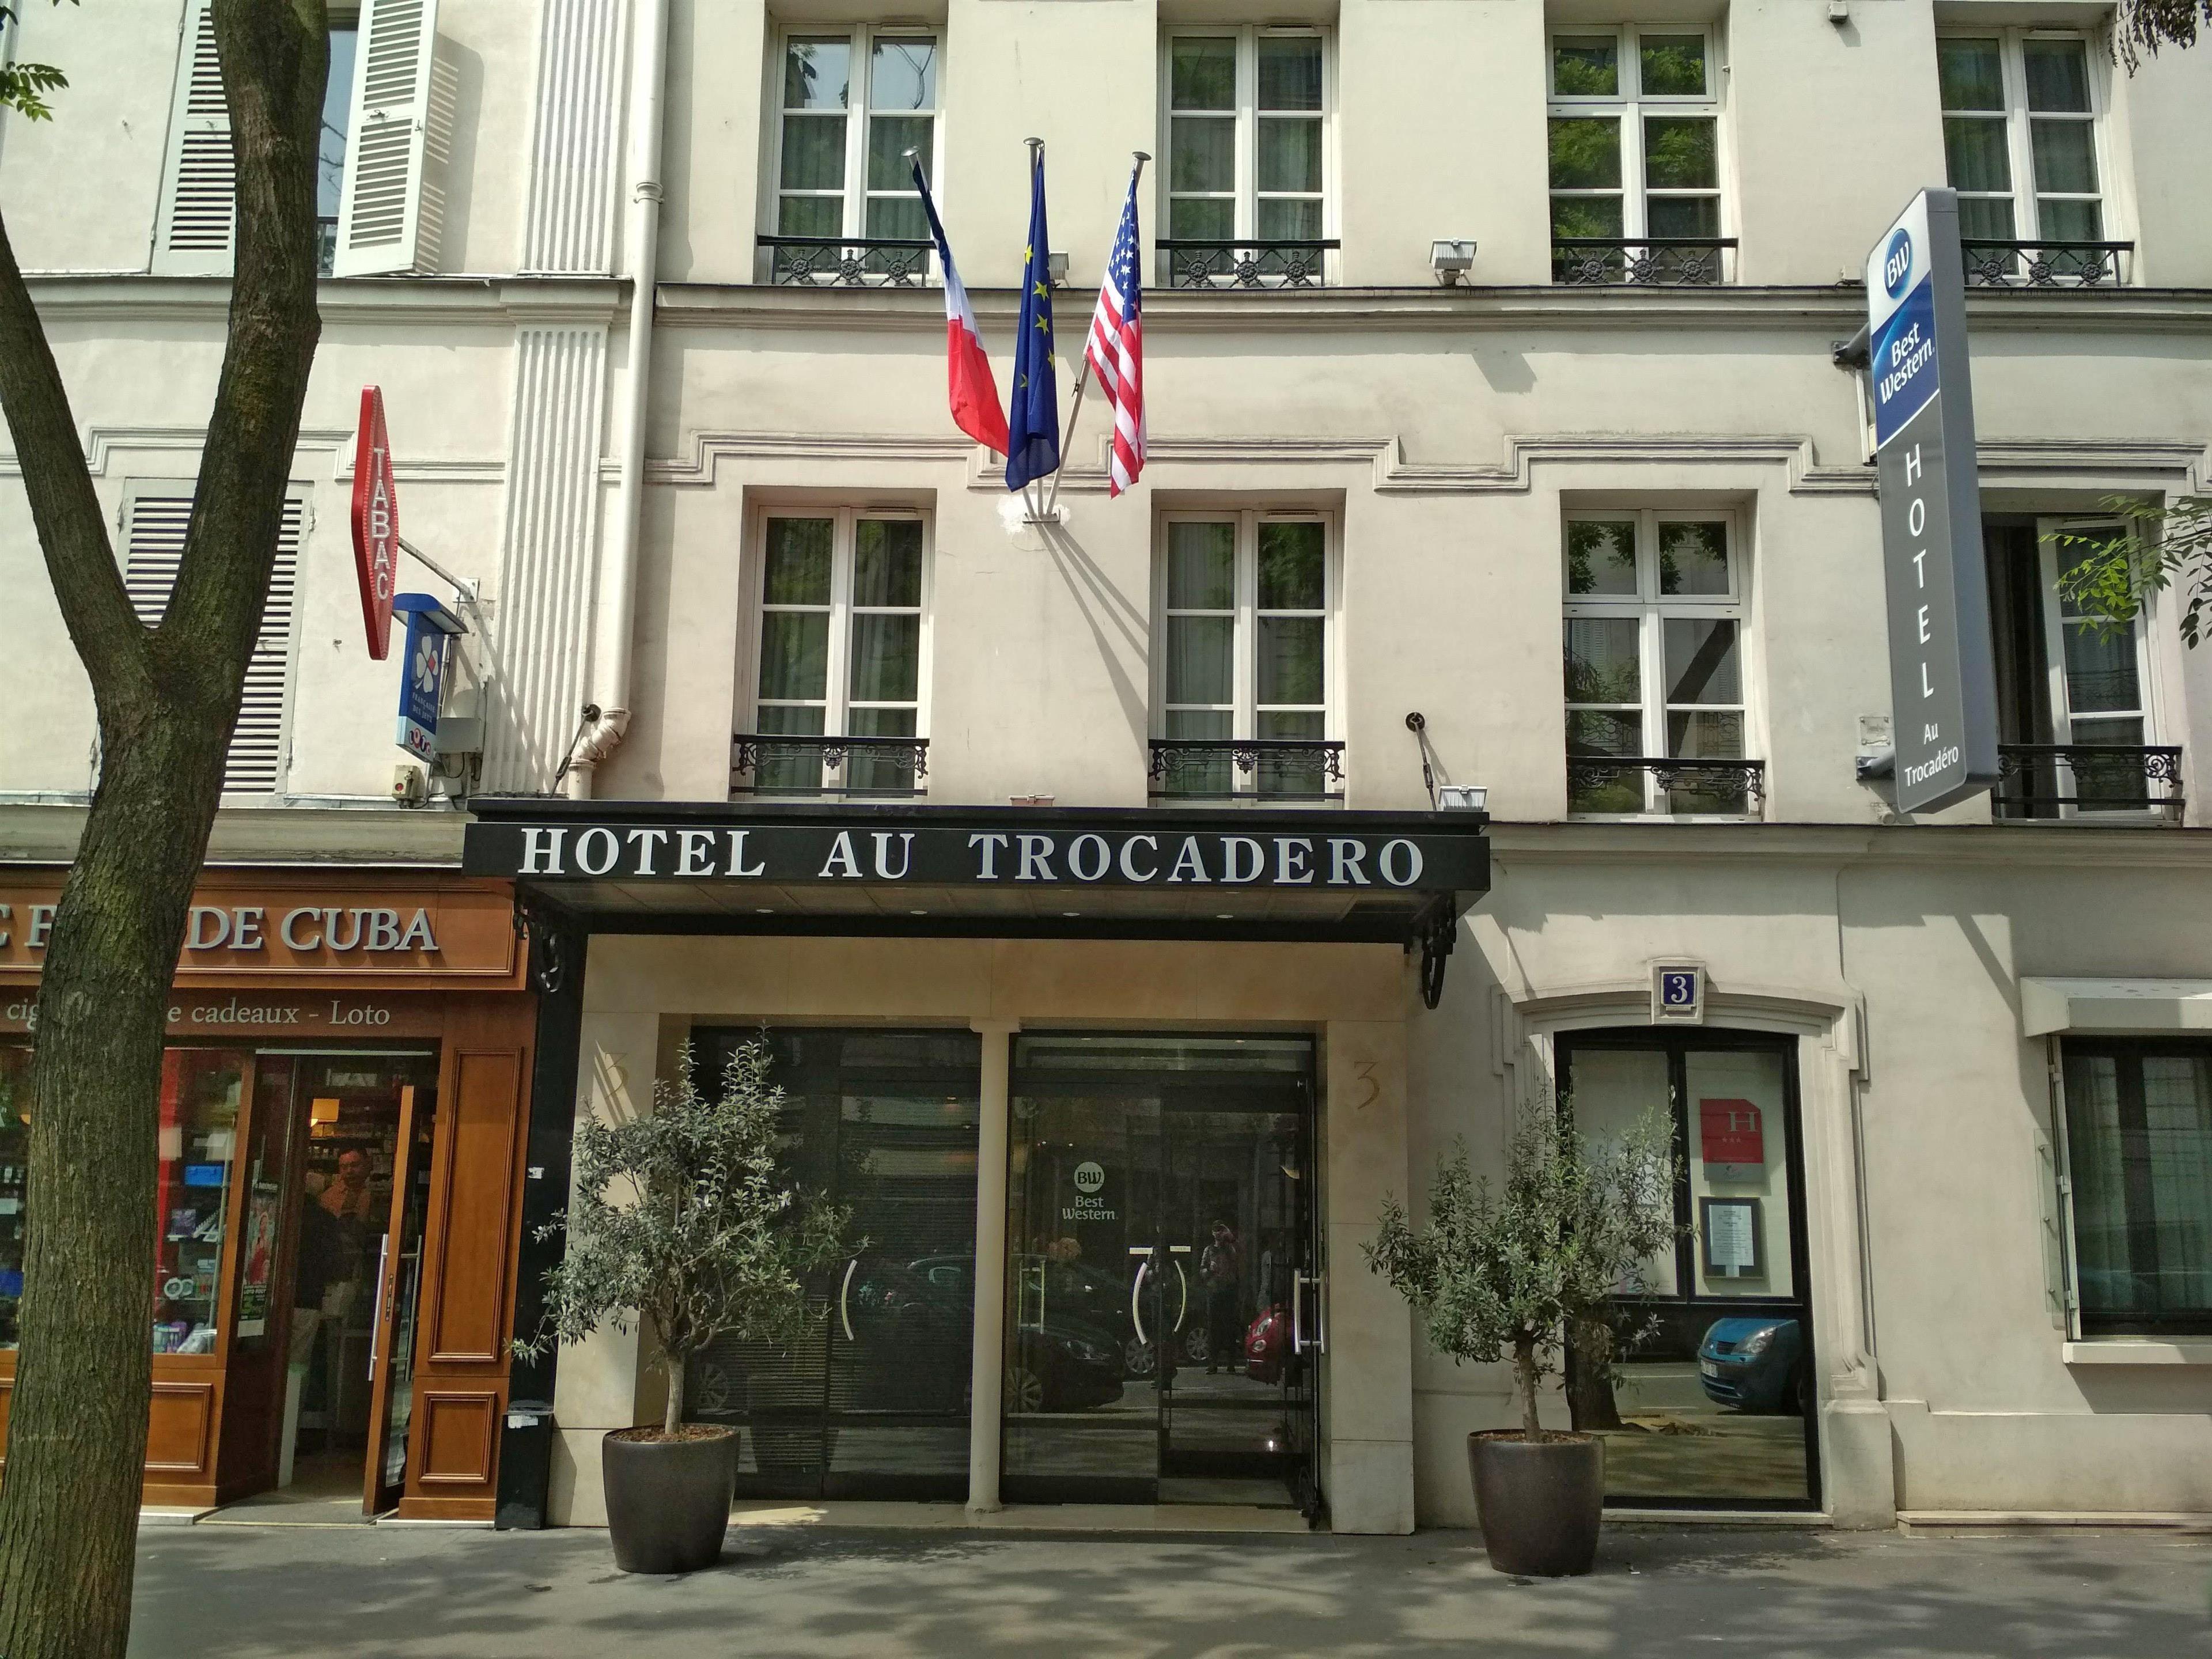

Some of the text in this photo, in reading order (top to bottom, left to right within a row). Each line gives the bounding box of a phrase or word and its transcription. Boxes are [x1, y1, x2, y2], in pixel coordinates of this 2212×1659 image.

[1887, 241, 1909, 288] BW
[1892, 321, 1920, 368] Best
[1880, 337, 1933, 404] Western
[372, 448, 391, 600] TABAC
[1906, 443, 1934, 698] HOTEL
[1924, 724, 1938, 744] Au
[1905, 747, 1959, 786] Trocadéro
[518, 828, 1423, 885] HOTEL AU TROCADERO
[185, 906, 439, 951] DE CUBA
[1671, 976, 1688, 1003] 3
[191, 997, 298, 1023] cadeaux
[329, 1000, 391, 1025] Loto
[1354, 1060, 1380, 1109] 3
[1728, 1112, 1758, 1132] H
[1078, 1172, 1101, 1184] BW
[1062, 1207, 1115, 1219] Western
[1075, 1195, 1104, 1207] Best
